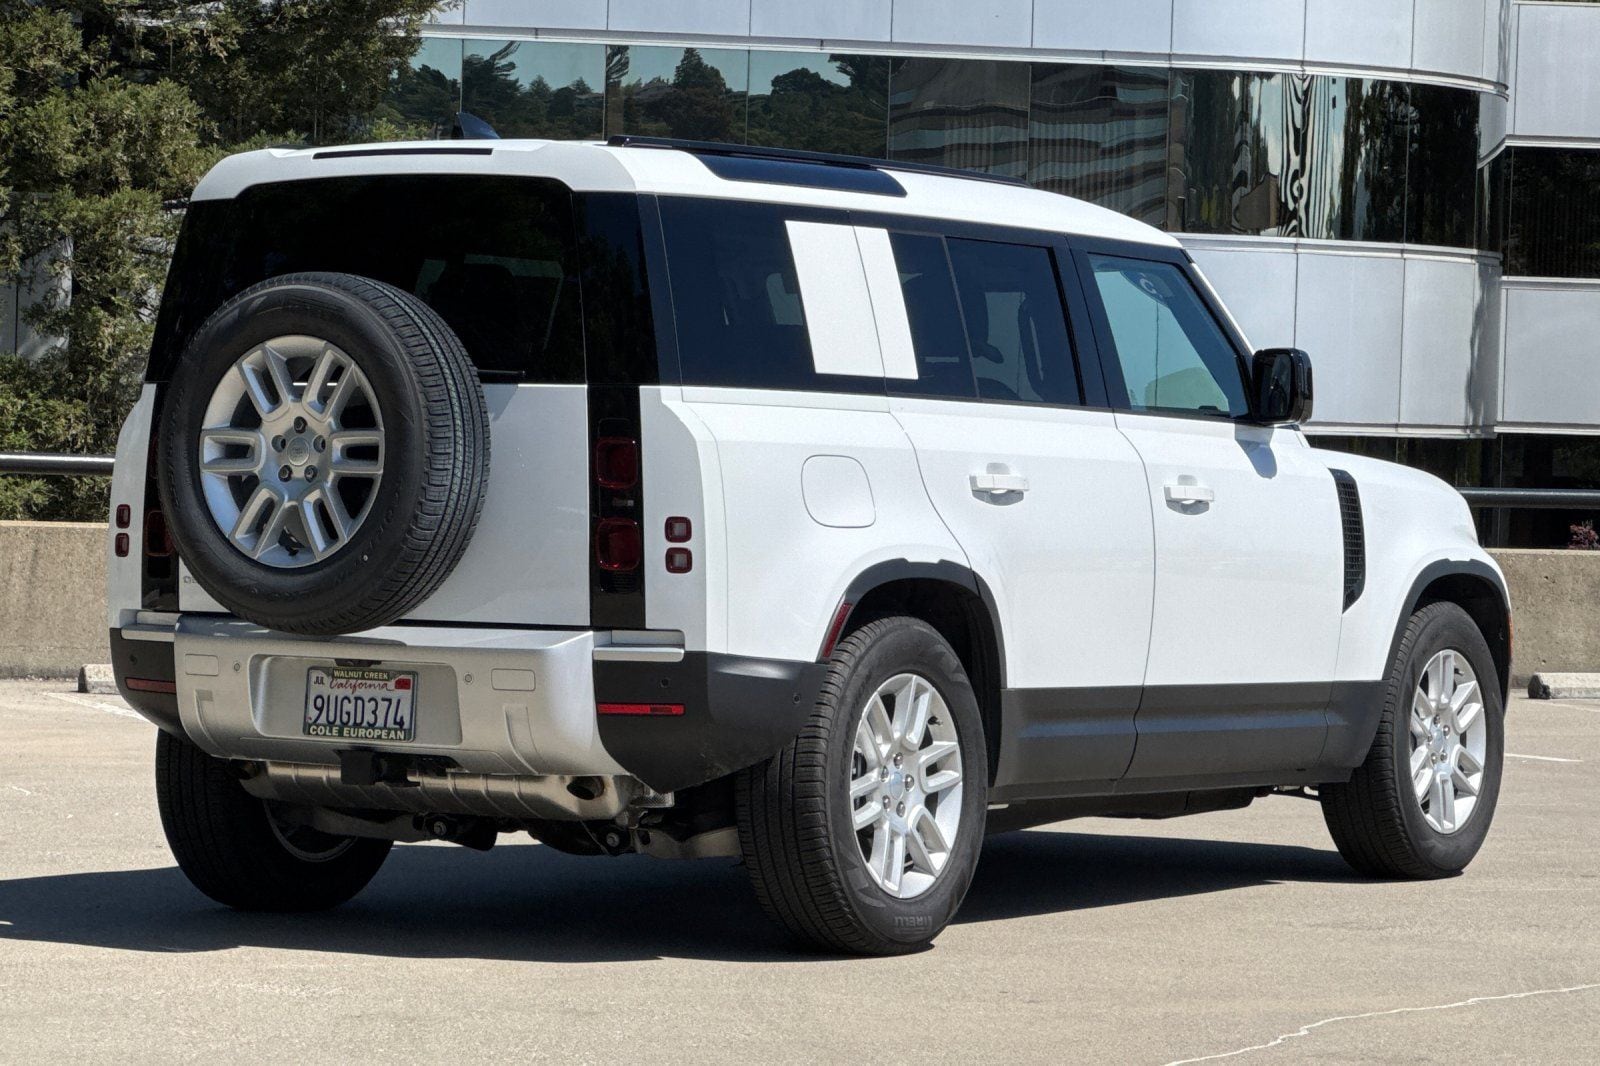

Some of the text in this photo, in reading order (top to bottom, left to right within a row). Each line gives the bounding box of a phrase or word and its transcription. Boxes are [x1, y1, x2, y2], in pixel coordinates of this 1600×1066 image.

[333, 669, 388, 680] WALNUT CREEK
[329, 679, 394, 695] California
[312, 694, 405, 729] 9UGD374
[309, 725, 405, 740] COLE EUROPEAN
[895, 915, 933, 932] PIRELLI
